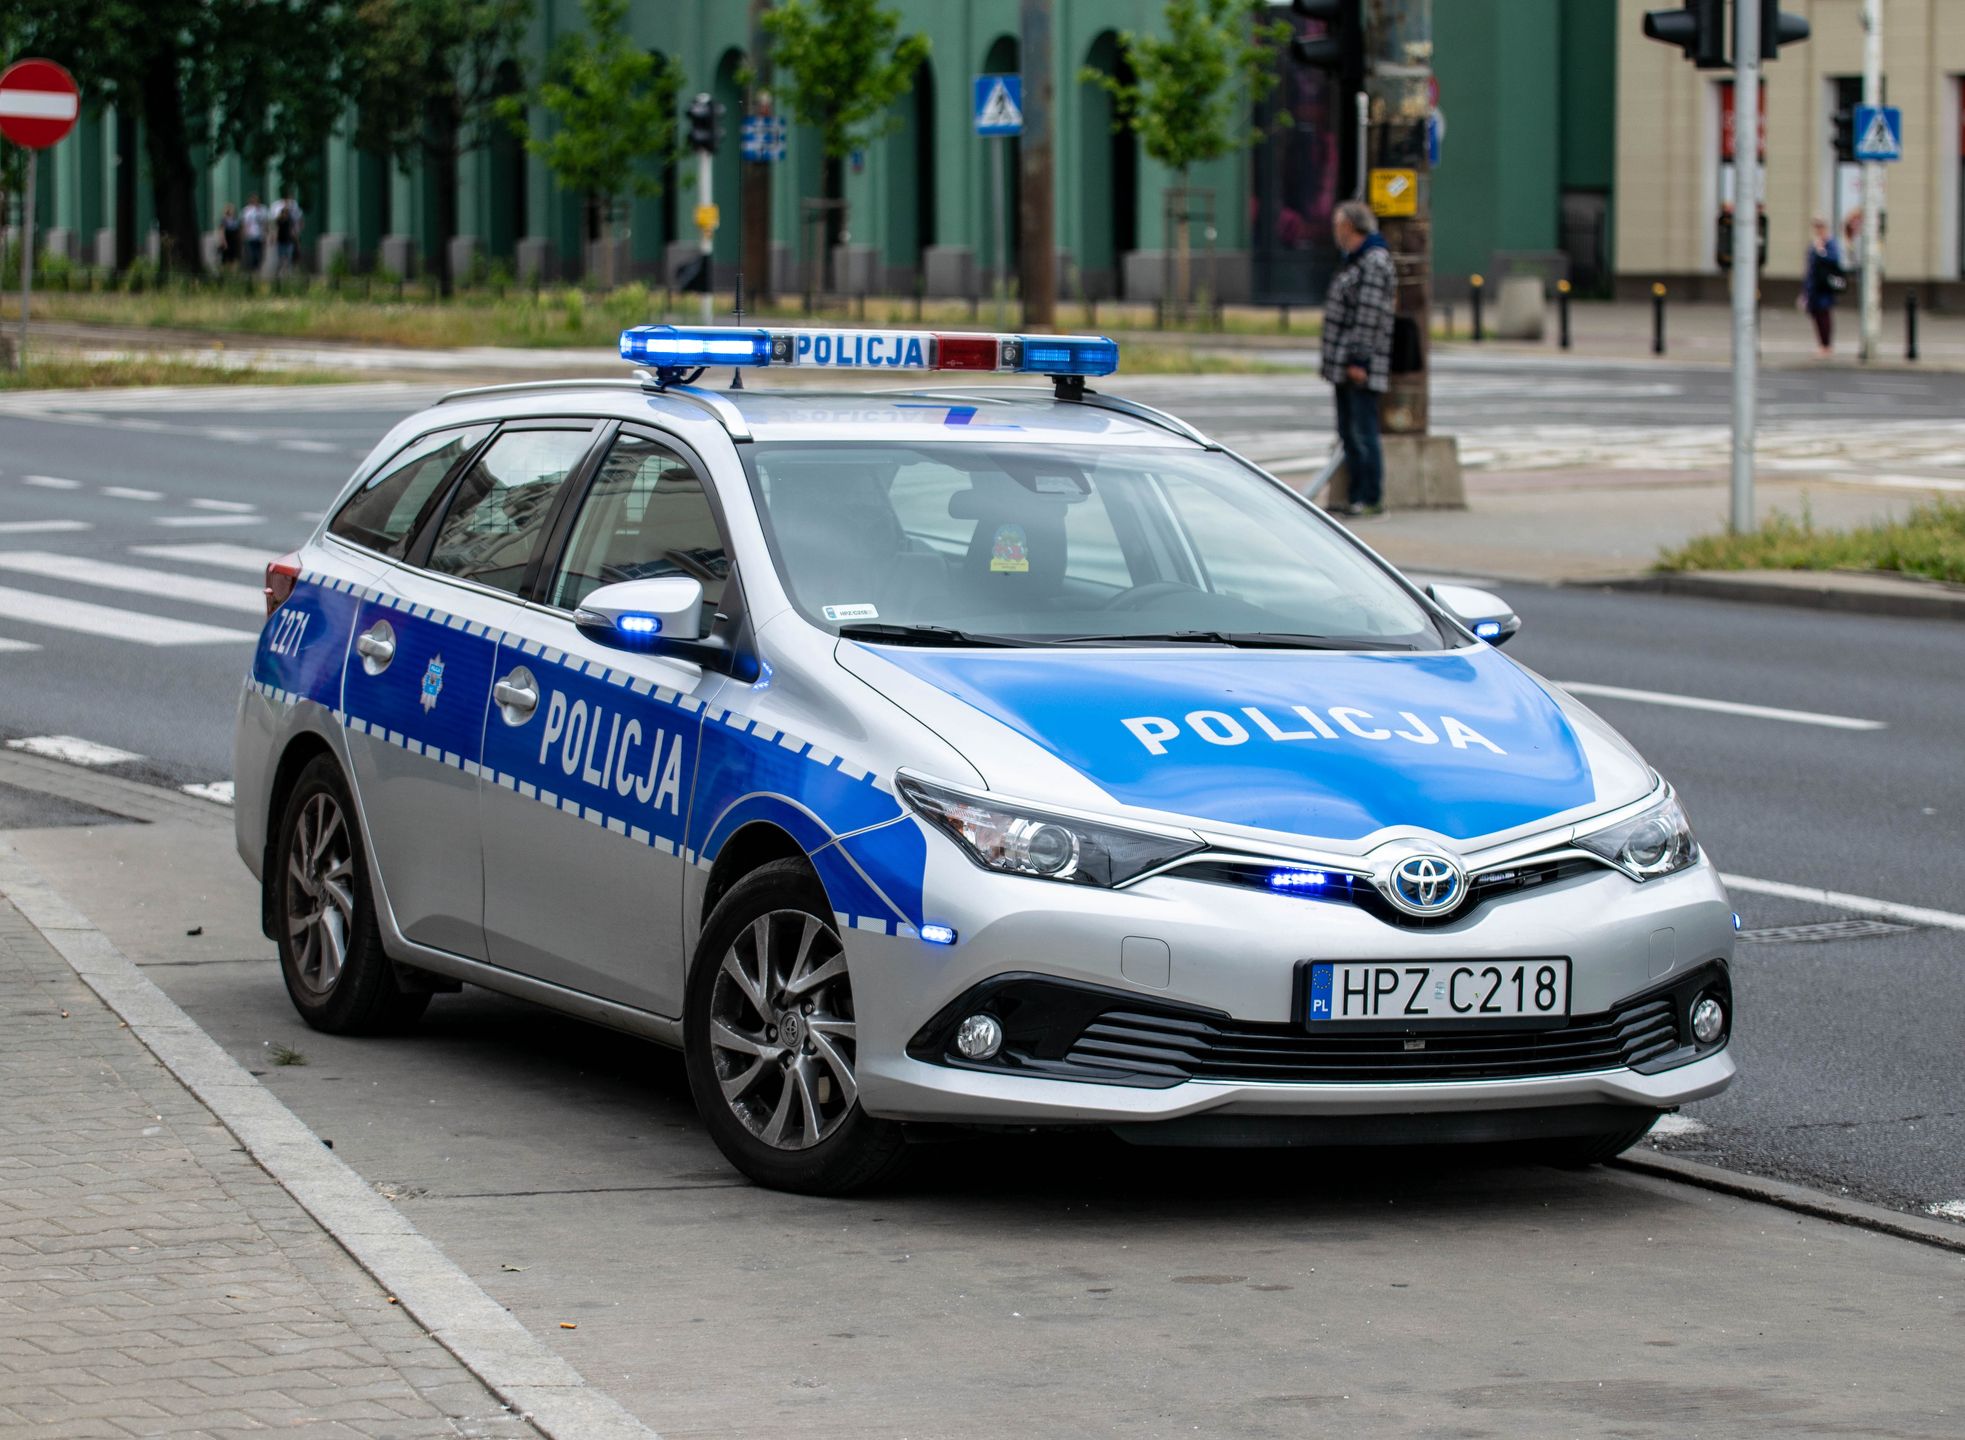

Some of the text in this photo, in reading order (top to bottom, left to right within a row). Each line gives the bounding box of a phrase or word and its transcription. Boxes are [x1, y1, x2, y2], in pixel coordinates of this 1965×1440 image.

[799, 333, 925, 368] POLICJA
[270, 608, 310, 657] Z271
[539, 689, 682, 816] POLICJA
[1120, 705, 1508, 755] POLICJA
[1313, 1000, 1328, 1012] PL
[1342, 967, 1430, 1016] HPZ
[1450, 965, 1557, 1013] C218
